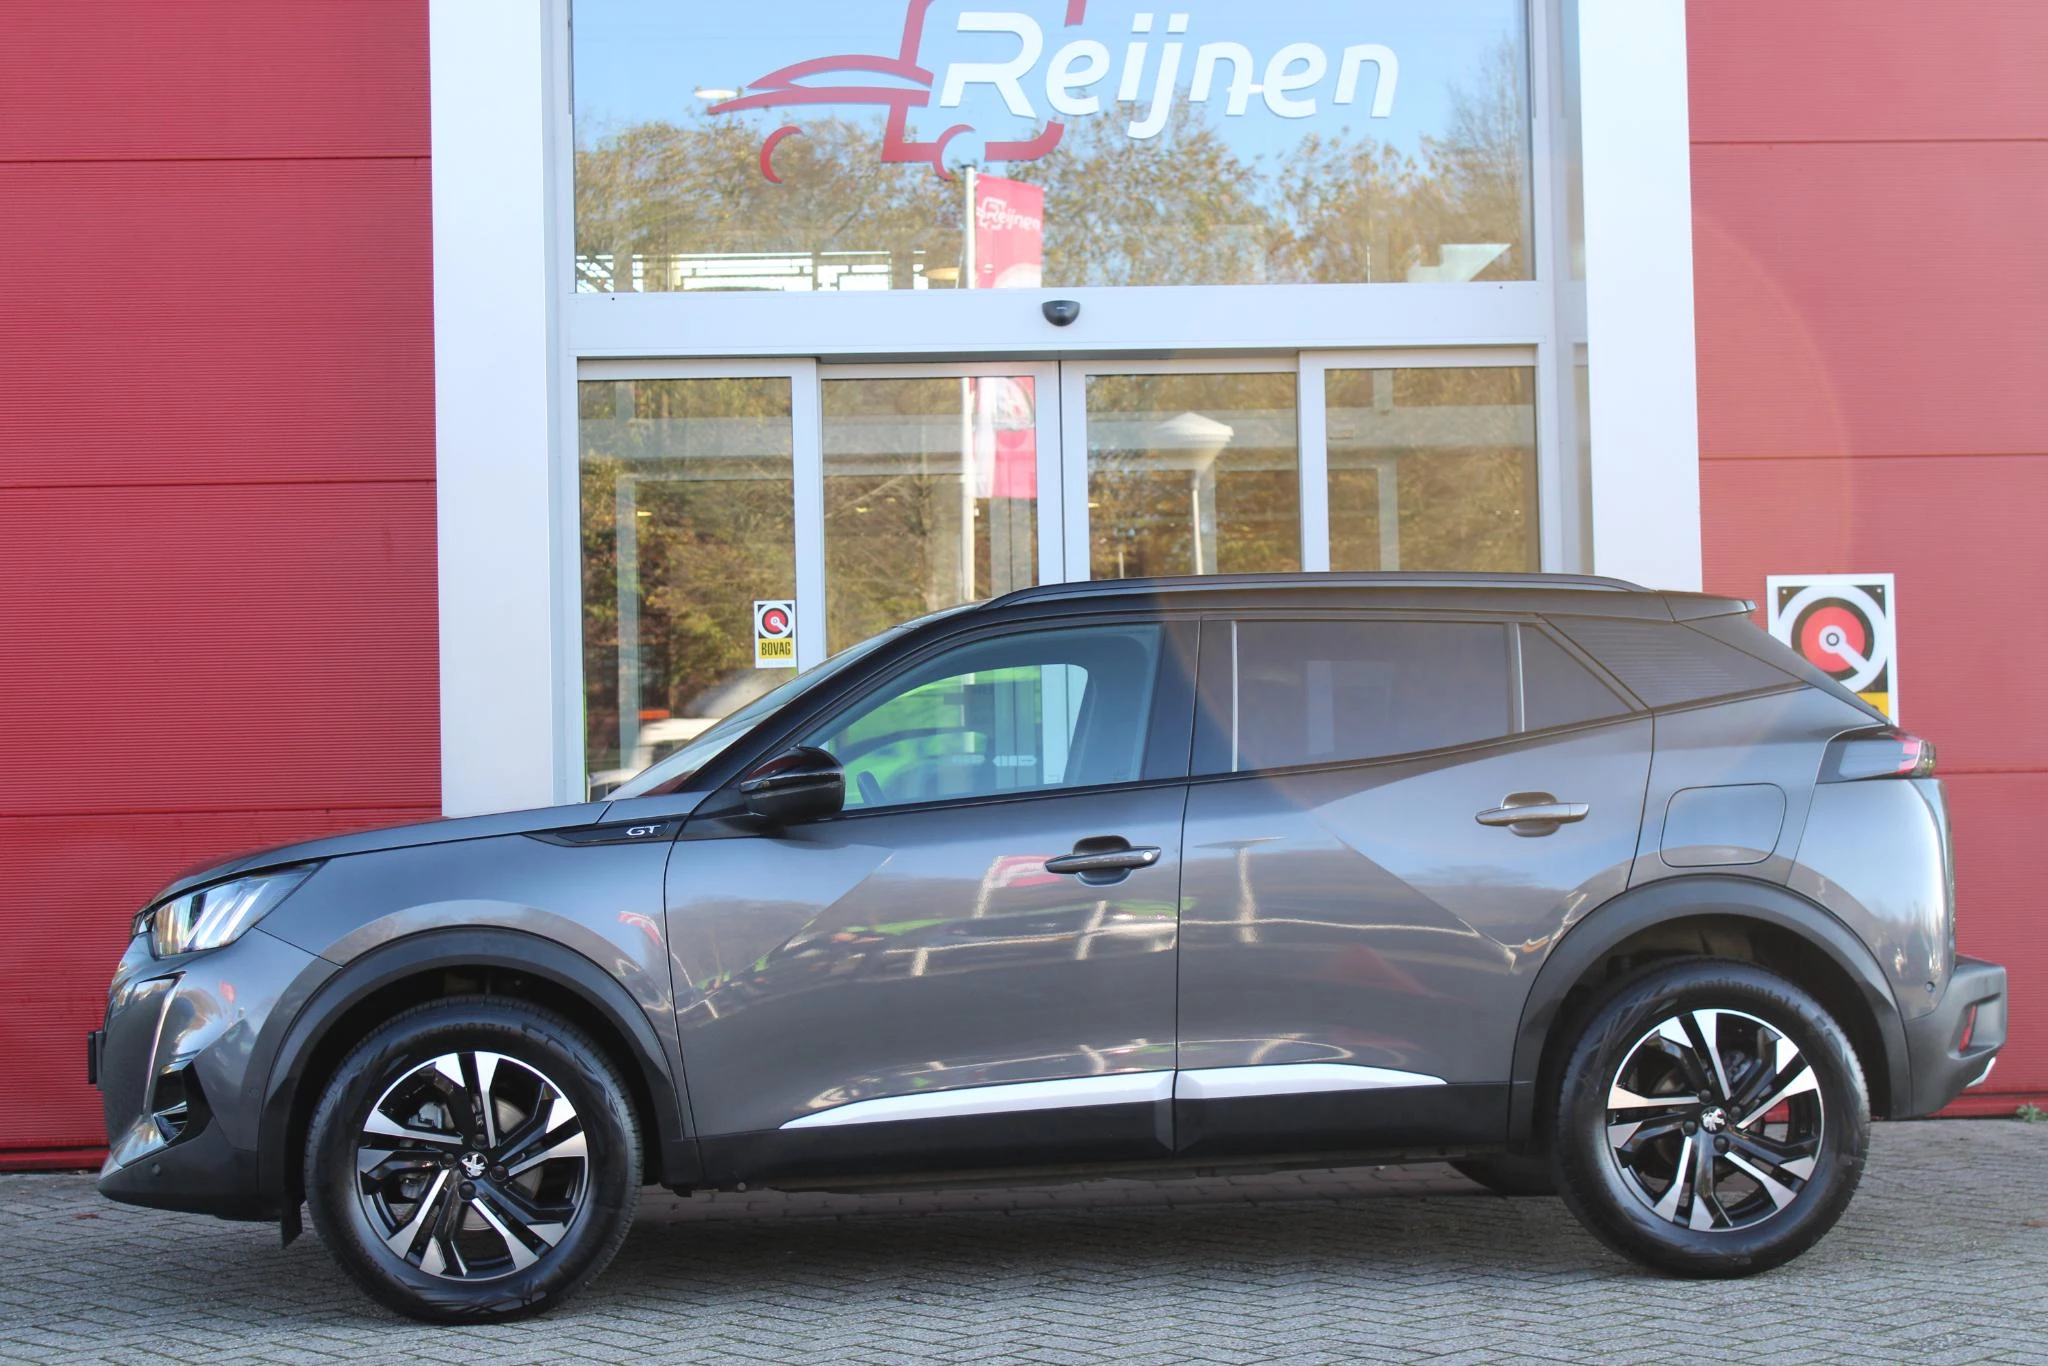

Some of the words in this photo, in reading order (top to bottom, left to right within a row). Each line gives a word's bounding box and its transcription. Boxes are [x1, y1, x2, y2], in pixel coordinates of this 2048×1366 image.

[939, 12, 1399, 139] Reijnen
[761, 641, 791, 656] BOVAG
[626, 824, 661, 836] GT
